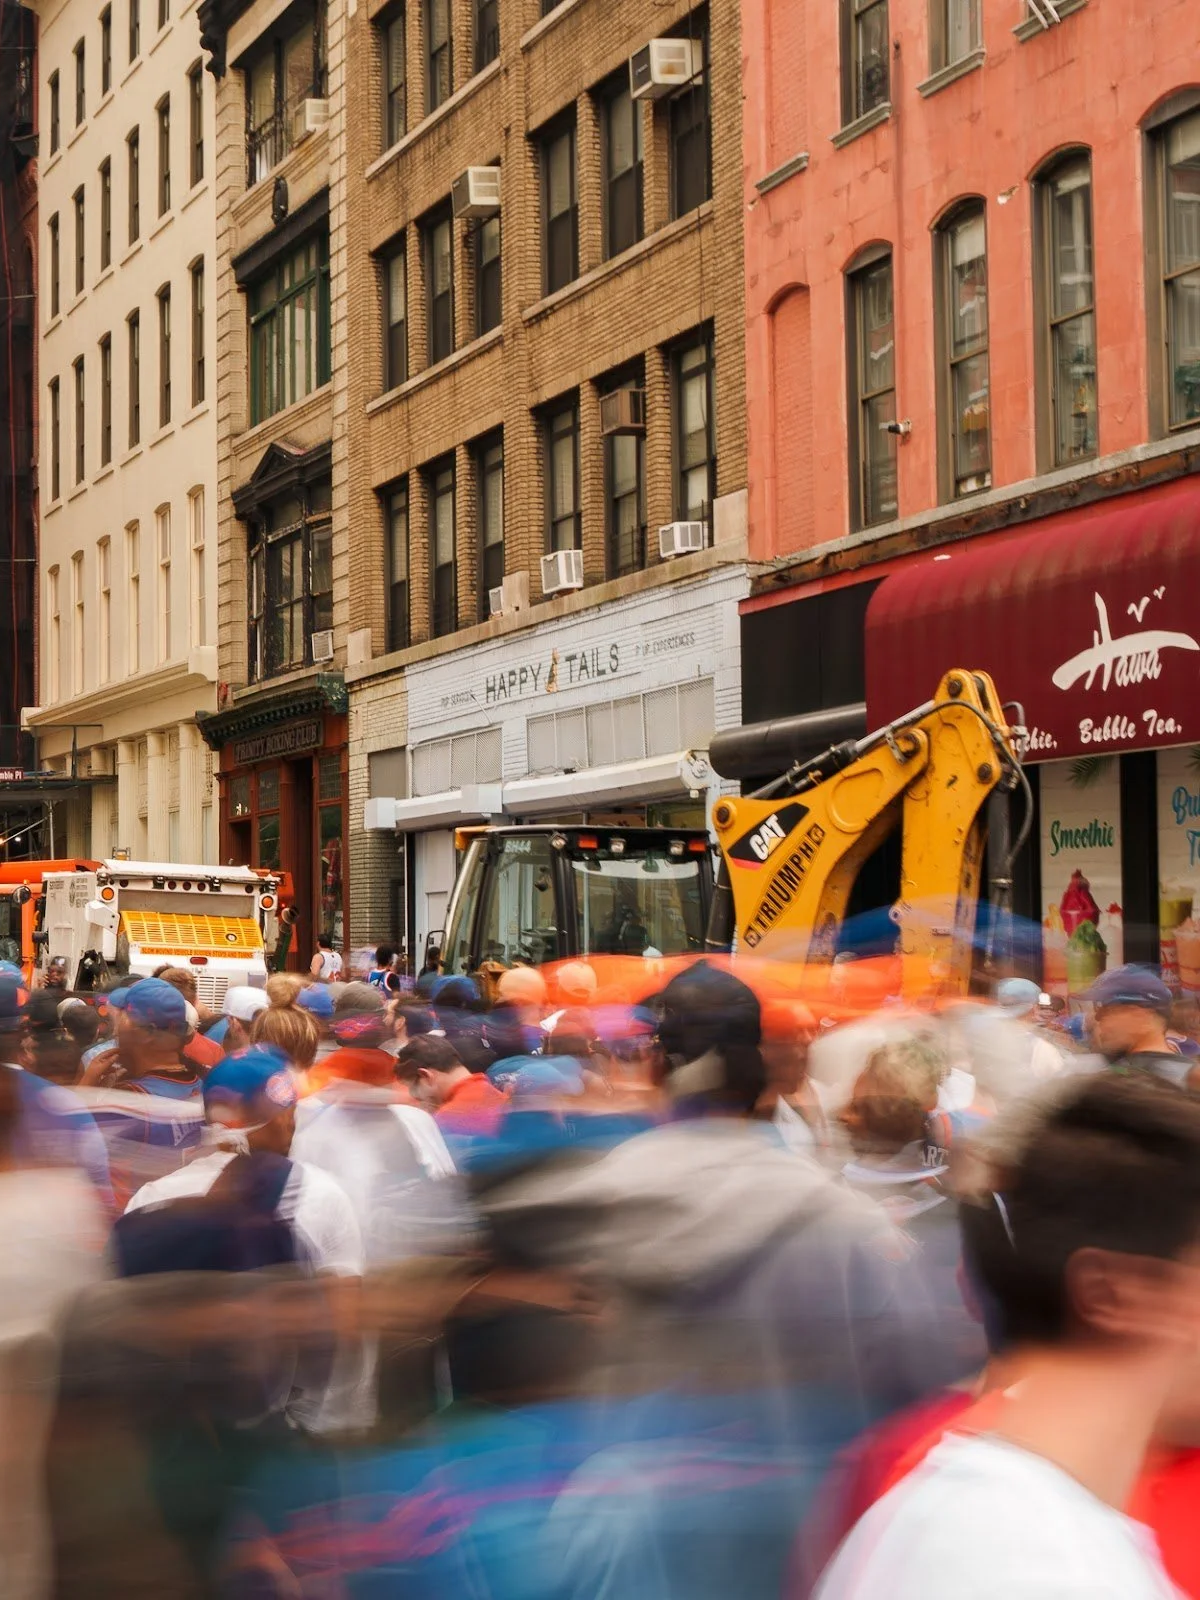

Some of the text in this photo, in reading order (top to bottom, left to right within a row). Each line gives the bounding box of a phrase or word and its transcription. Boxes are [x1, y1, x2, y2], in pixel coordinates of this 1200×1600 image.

[485, 643, 619, 703] HAPPY TAILS
[266, 730, 296, 754] BOXING
[297, 724, 317, 747] CLUB
[1079, 715, 1136, 743] Bubble
[15, 770, 22, 779] Pl
[750, 814, 786, 861] CAT
[1050, 819, 1114, 857] Smoothie
[754, 840, 815, 930] TRIUMPH
